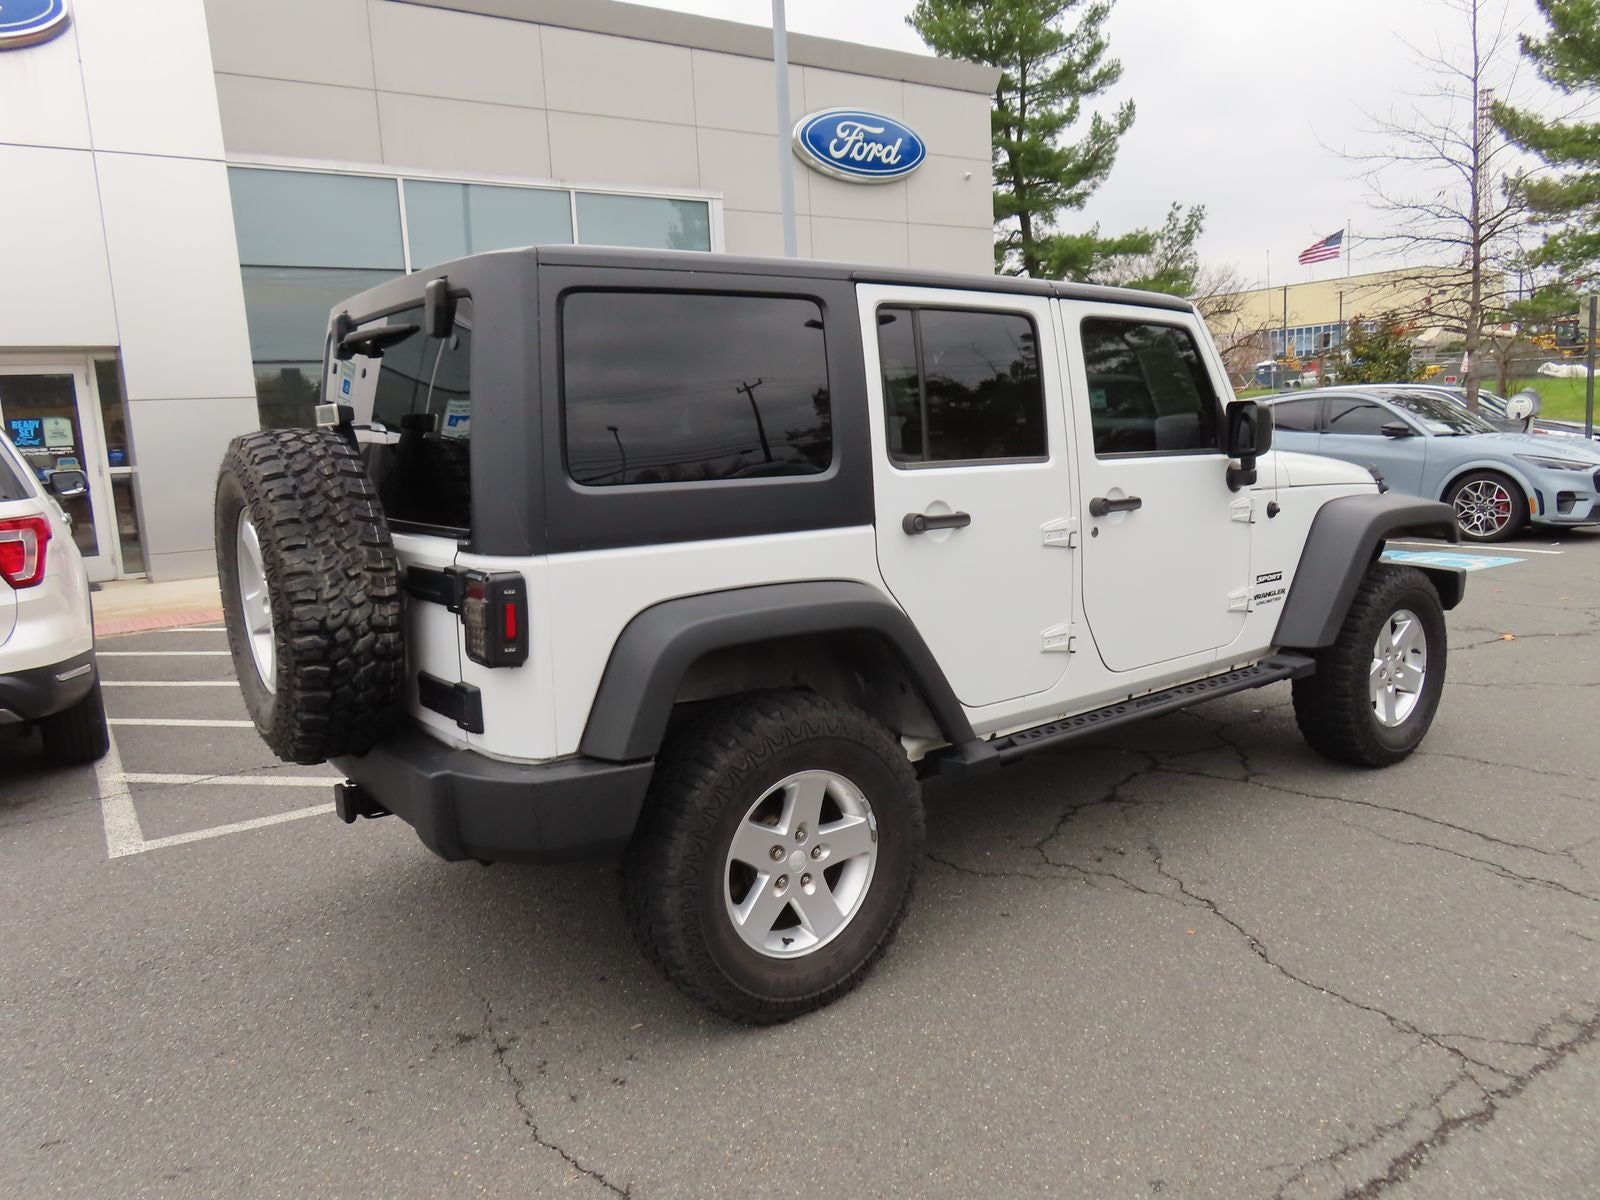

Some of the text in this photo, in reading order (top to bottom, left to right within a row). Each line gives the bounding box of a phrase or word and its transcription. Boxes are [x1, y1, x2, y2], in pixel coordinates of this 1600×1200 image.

[829, 121, 902, 164] Ford
[11, 420, 40, 429] READY
[19, 428, 34, 437] SET
[1256, 572, 1281, 583] SPORT
